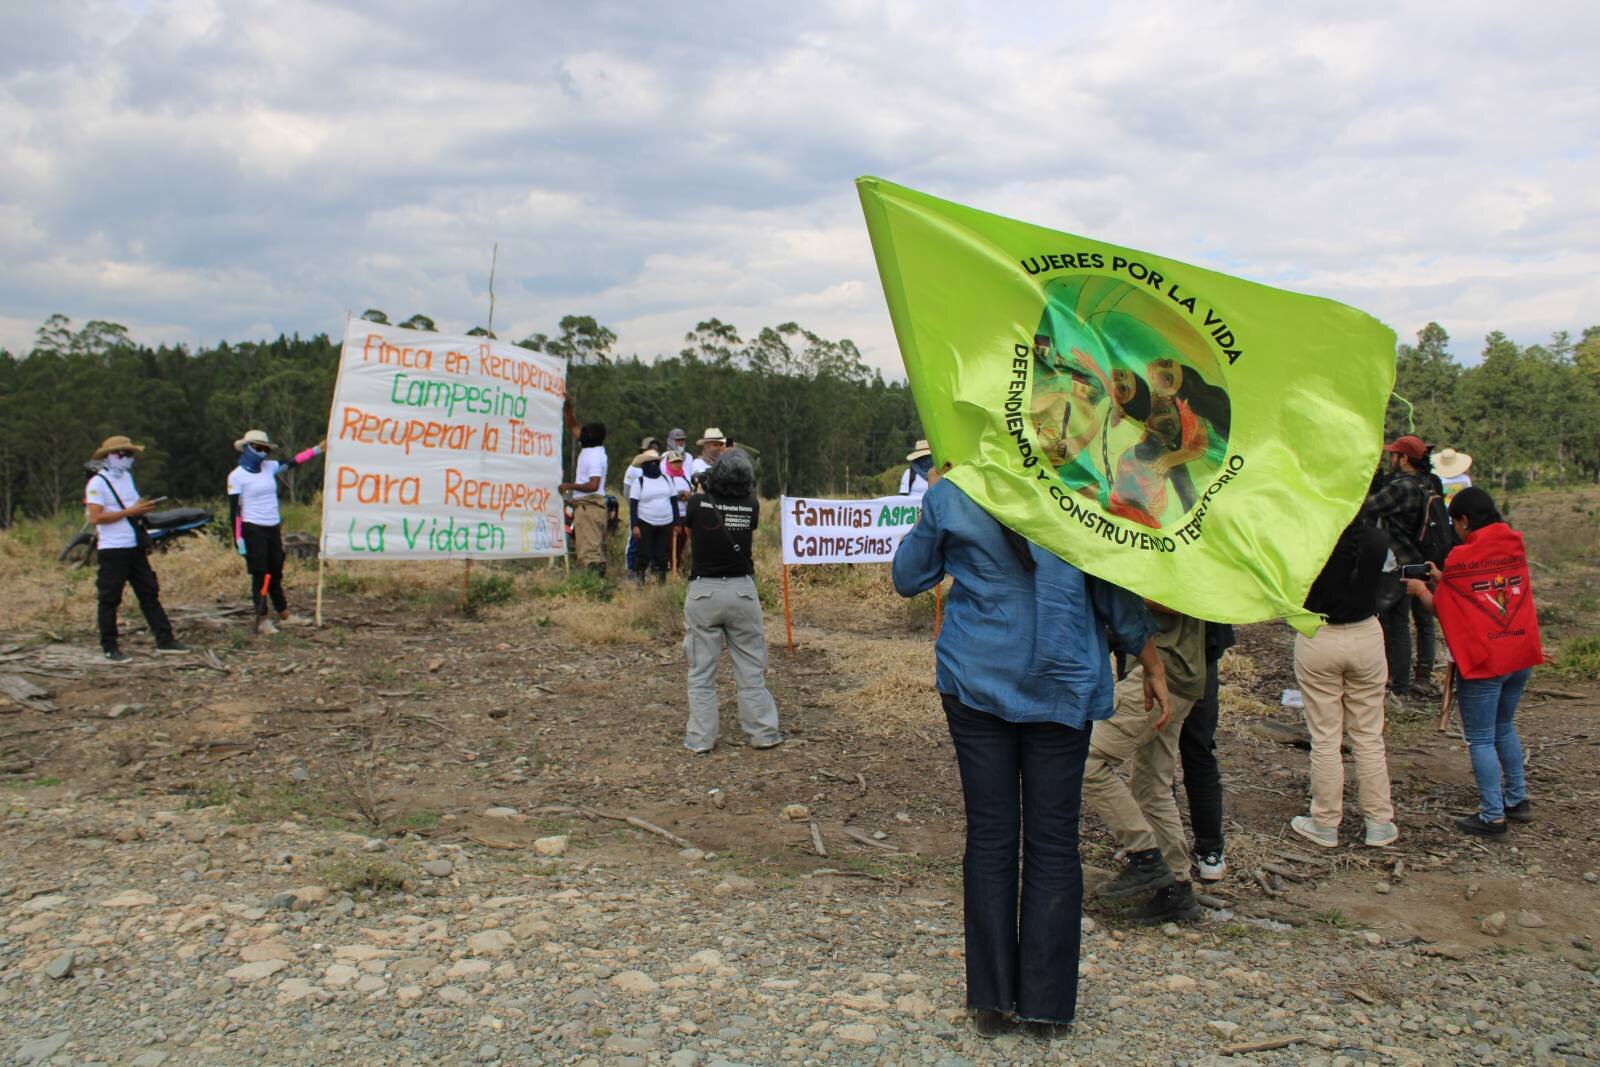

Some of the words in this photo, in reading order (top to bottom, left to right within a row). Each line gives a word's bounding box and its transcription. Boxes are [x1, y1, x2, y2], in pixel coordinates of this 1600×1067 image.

[1021, 253, 1105, 275] UJERES
[1112, 256, 1164, 290] POR
[1168, 284, 1197, 314] LA
[1204, 308, 1243, 366] VIDA
[363, 334, 432, 371] Finca
[444, 351, 470, 376] en
[339, 407, 477, 456] Recuperar
[482, 422, 499, 453] la
[508, 418, 553, 457] Tierra
[1004, 343, 1039, 468] DEFENDIENDO
[1036, 468, 1050, 482] Y
[1049, 485, 1176, 553] CONSTRUYENDO
[1175, 454, 1245, 546] TERRITORIO
[336, 466, 421, 506] Para
[444, 468, 551, 521] Recuperar
[791, 500, 872, 529] familias
[877, 505, 919, 527] Agra
[349, 516, 387, 552] La
